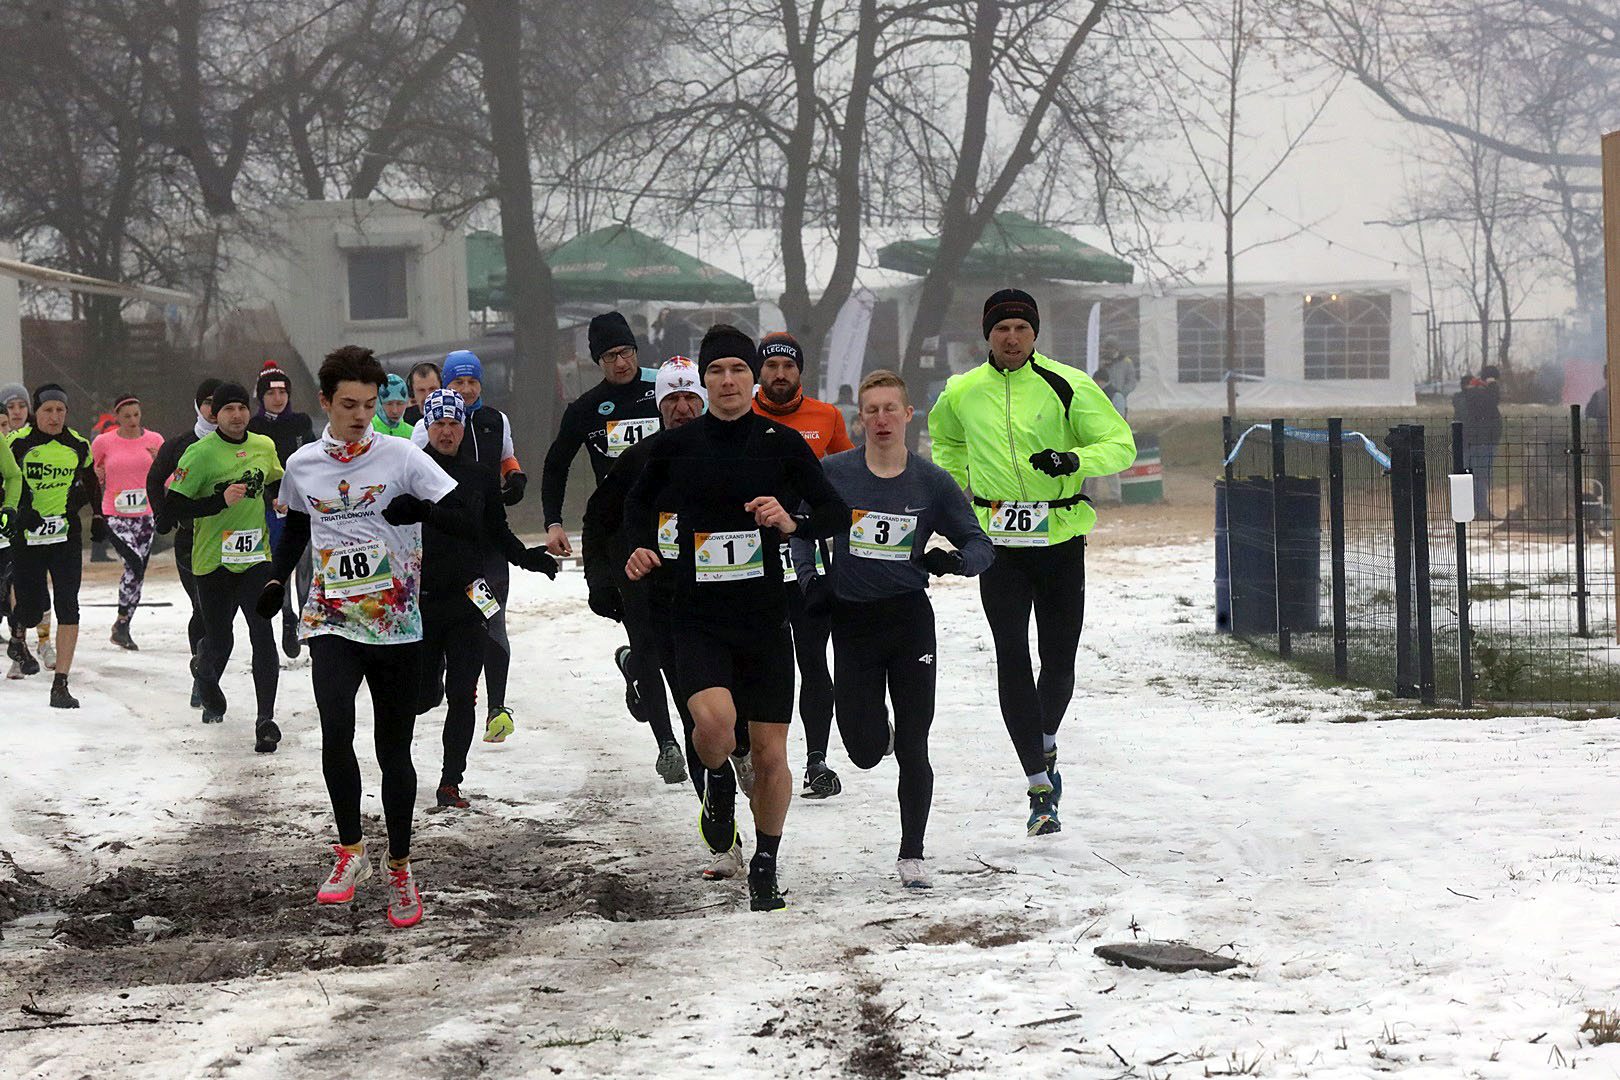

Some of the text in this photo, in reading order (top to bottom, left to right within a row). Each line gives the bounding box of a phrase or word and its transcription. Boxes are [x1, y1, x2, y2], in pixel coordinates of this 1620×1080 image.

[766, 347, 796, 358] LEGNICA
[624, 425, 643, 444] 41
[126, 493, 137, 505] 11
[321, 511, 375, 522] TRIATHLONOWA
[1004, 509, 1031, 531] 26
[39, 521, 56, 535] 25
[875, 521, 890, 544] 3
[235, 535, 252, 552] 45
[723, 540, 734, 564] 1
[340, 553, 370, 580] 48
[918, 653, 934, 664] 4F
